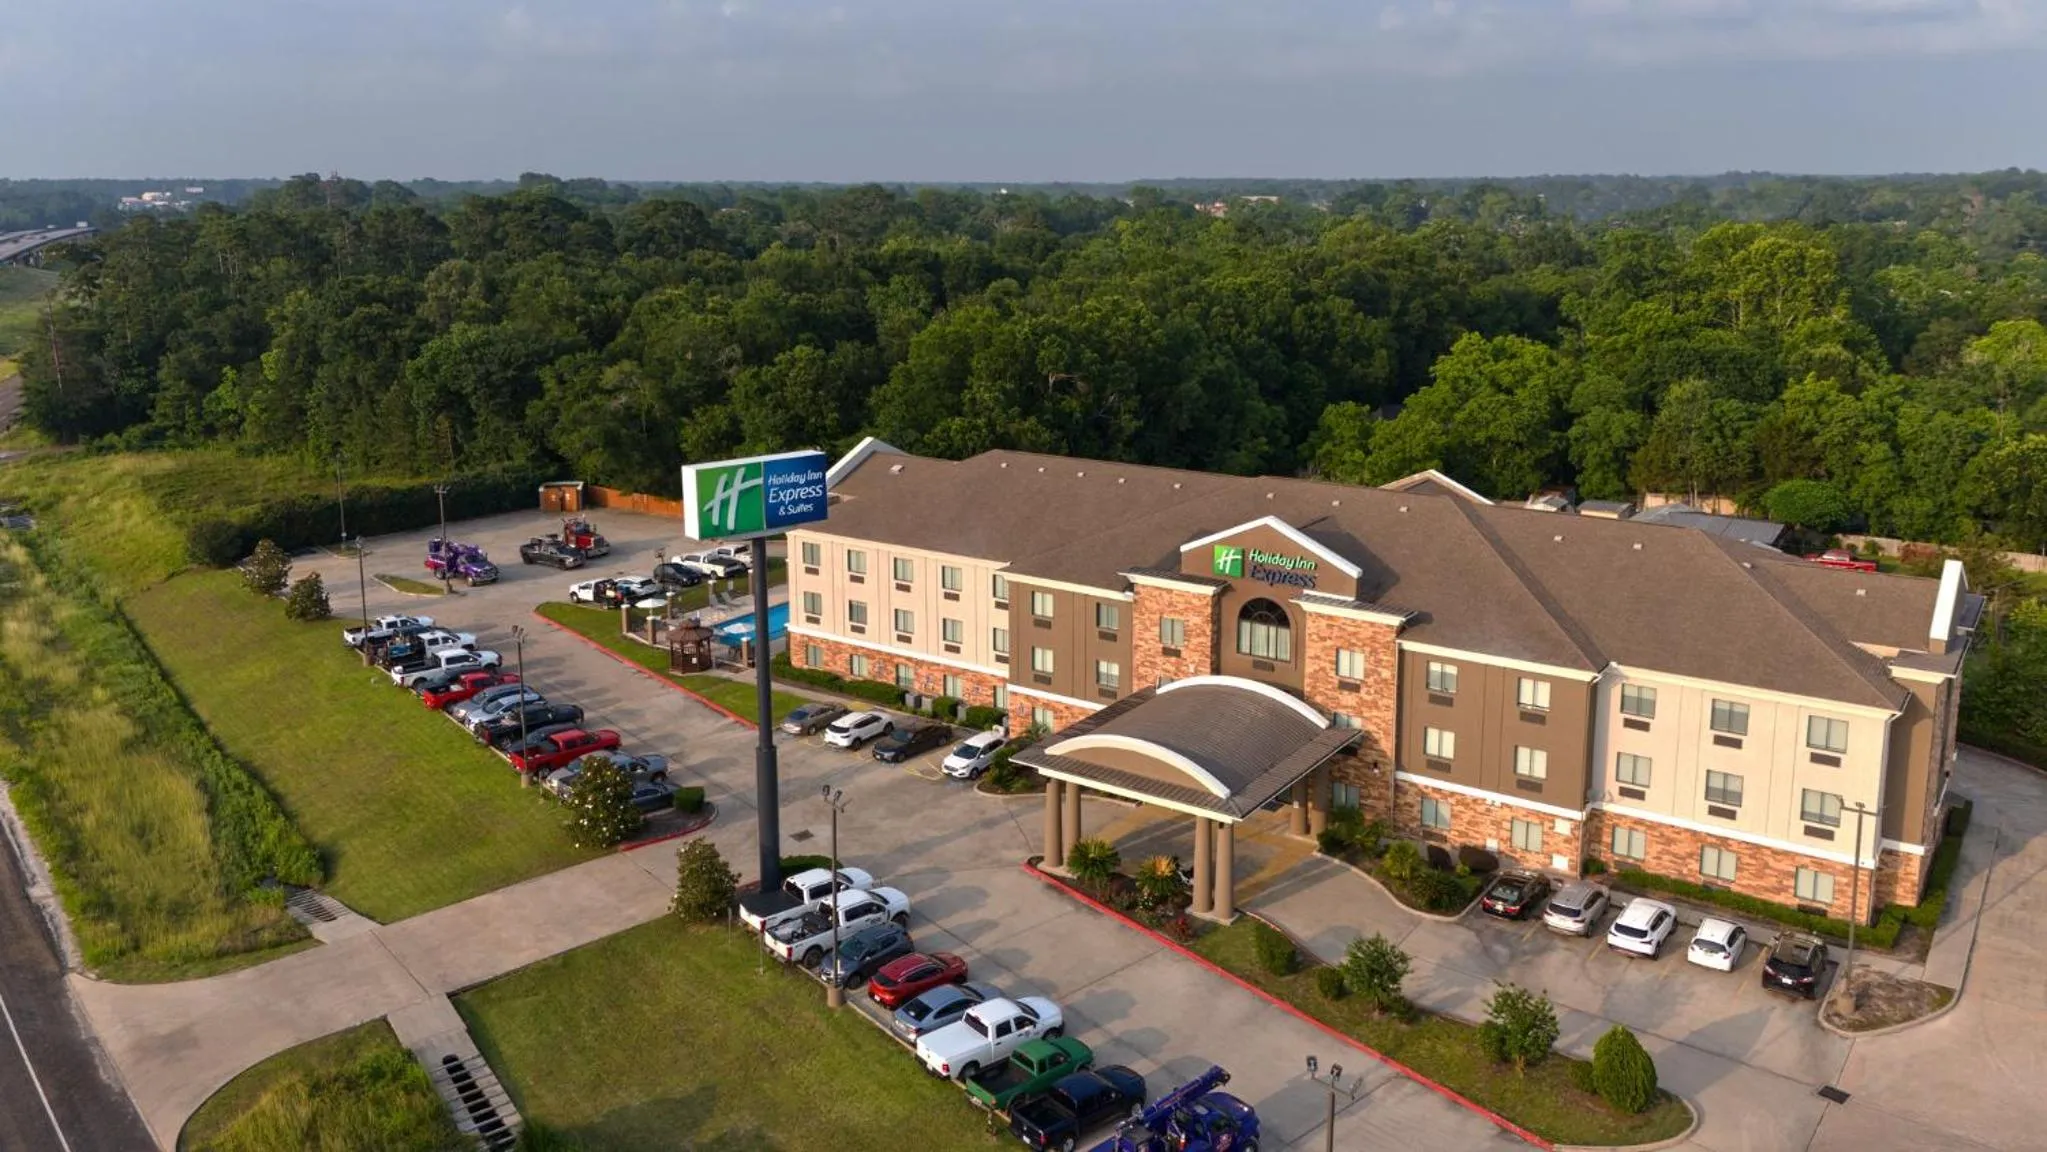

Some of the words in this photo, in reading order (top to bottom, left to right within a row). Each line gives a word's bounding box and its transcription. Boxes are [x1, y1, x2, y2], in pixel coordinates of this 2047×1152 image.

[768, 472, 806, 485] Holiday
[807, 469, 823, 481] Inn
[768, 484, 823, 505] Express
[778, 505, 786, 516] &
[787, 503, 815, 515] Suites
[1249, 548, 1294, 570] Holiday
[1295, 555, 1316, 571] Inn
[1250, 564, 1317, 588] Express
